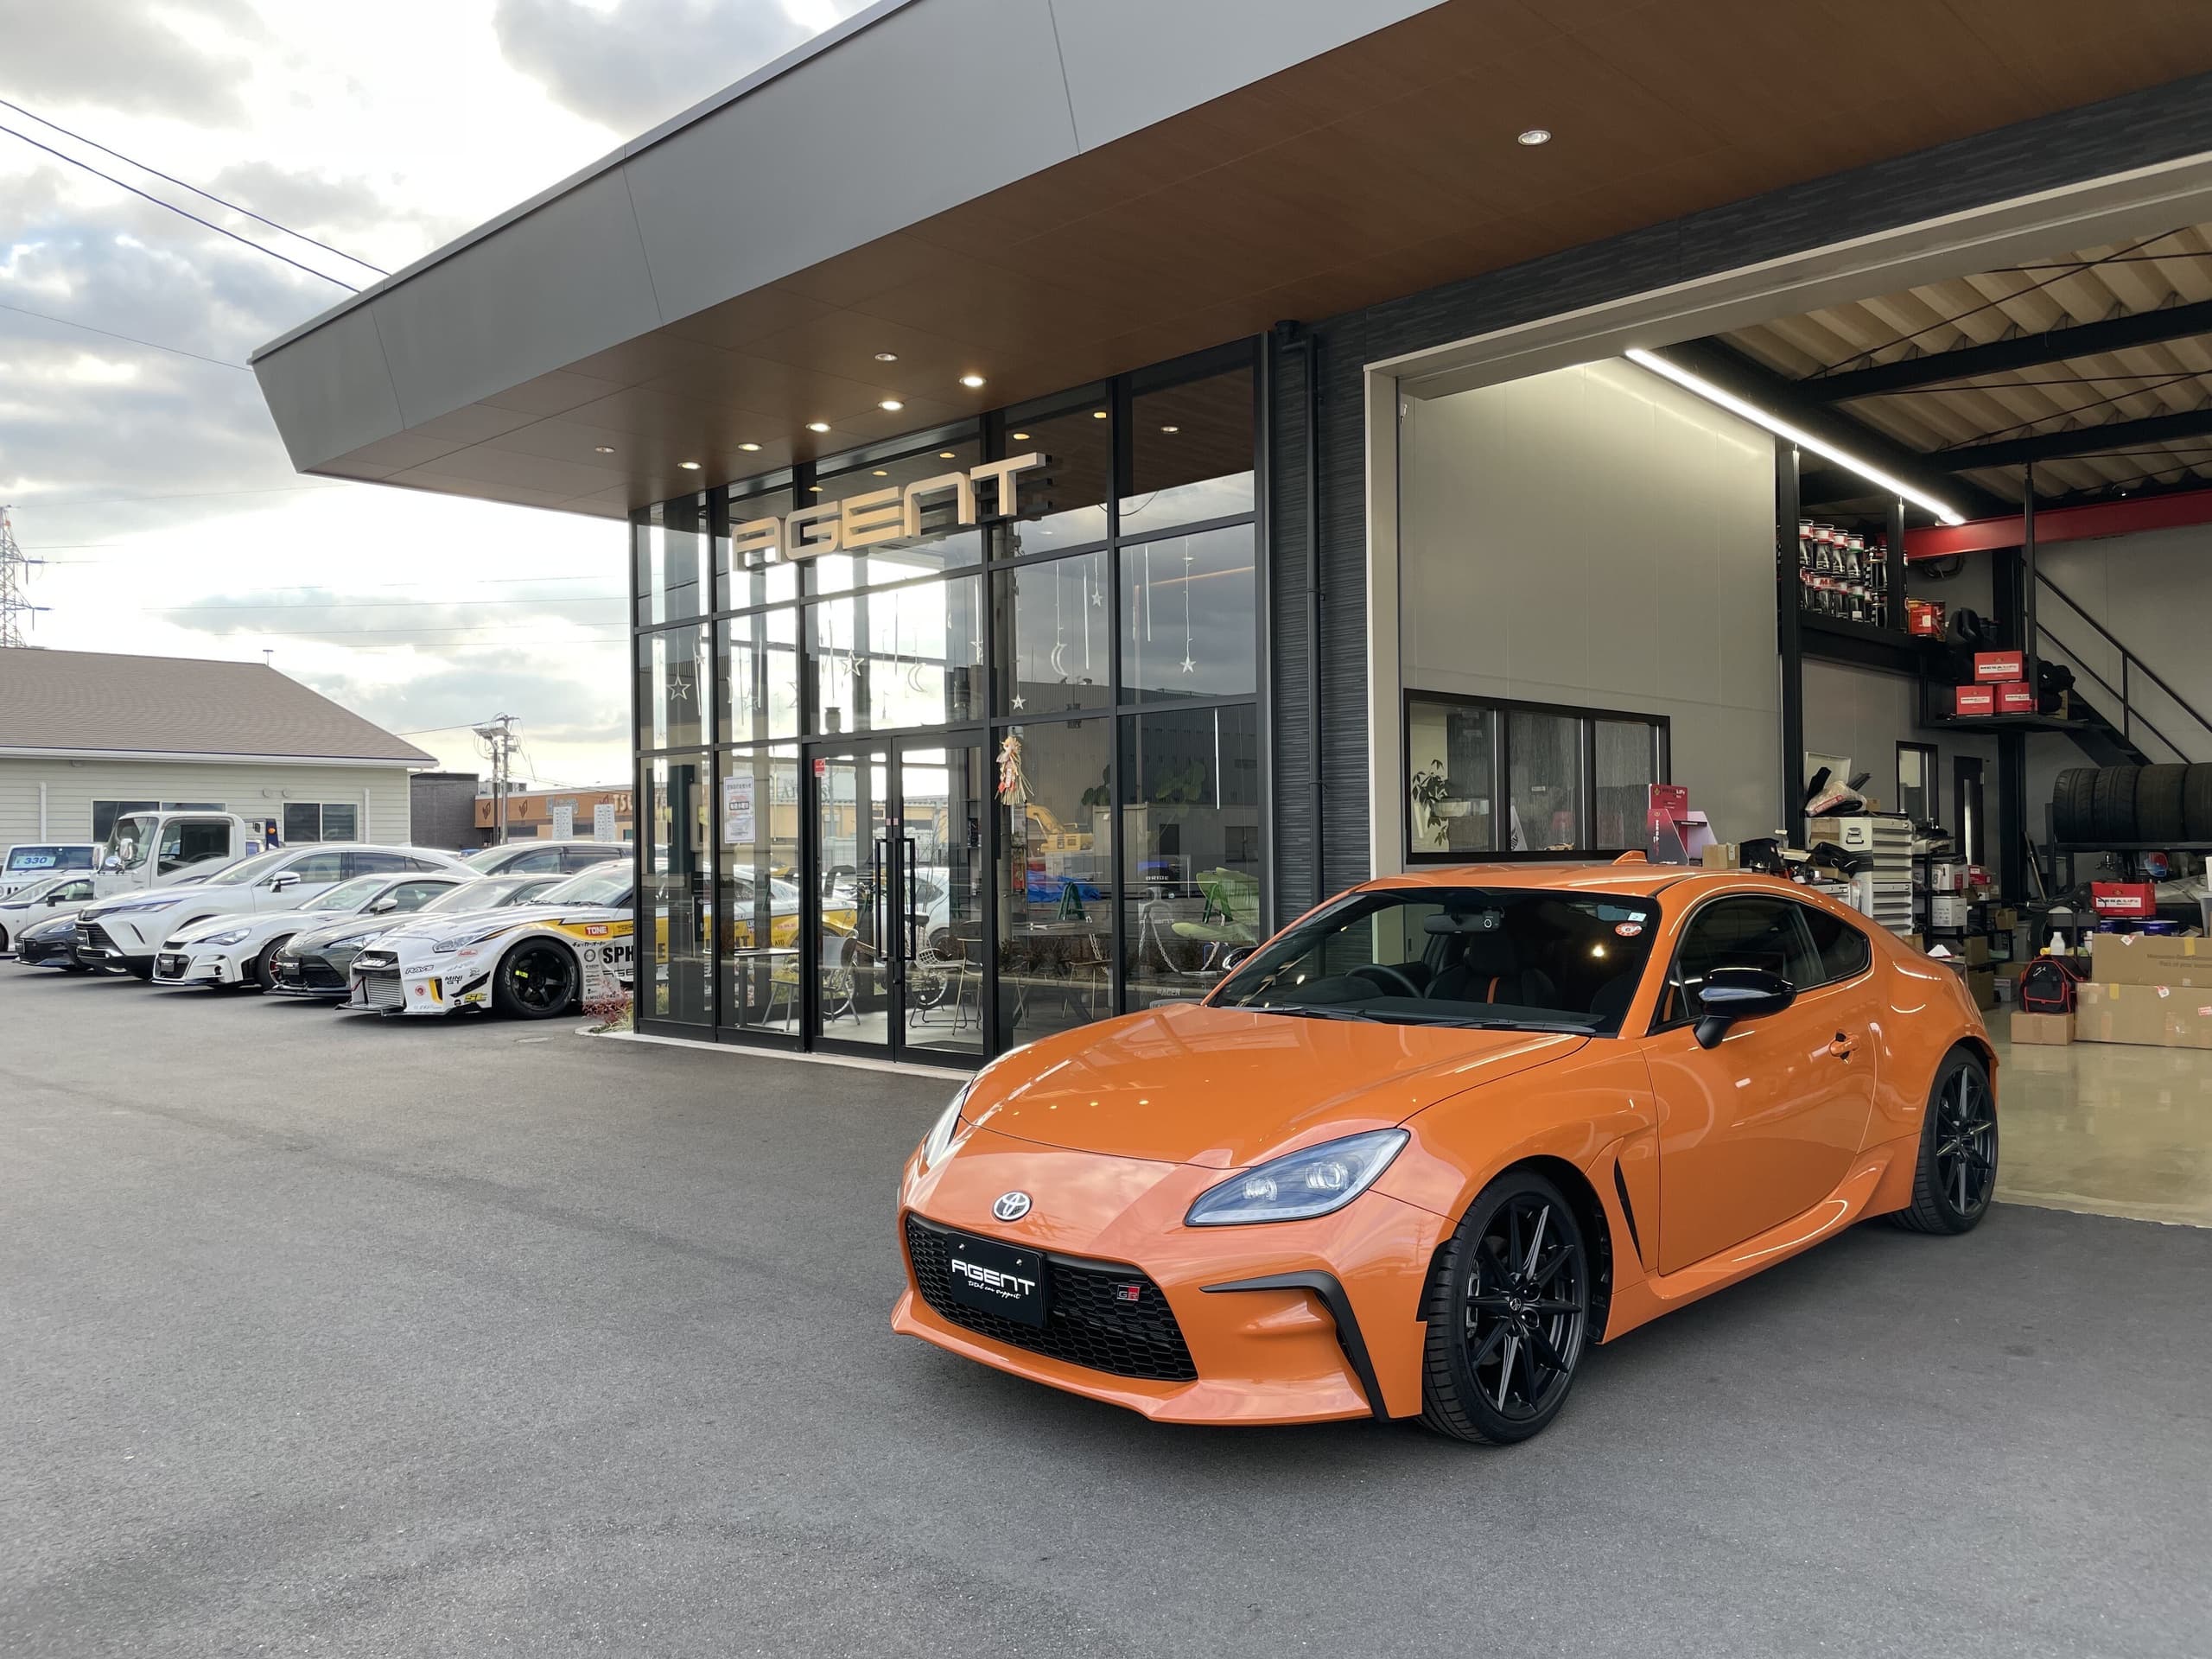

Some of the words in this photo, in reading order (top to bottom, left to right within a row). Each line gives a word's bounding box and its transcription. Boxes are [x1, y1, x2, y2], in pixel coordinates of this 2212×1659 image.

[732, 452, 1046, 572] AGENT
[587, 925, 607, 934] TONE
[405, 965, 435, 975] RAYS
[951, 1258, 1035, 1295] AGENT
[995, 1289, 1021, 1300] support
[1118, 1290, 1139, 1300] GR
